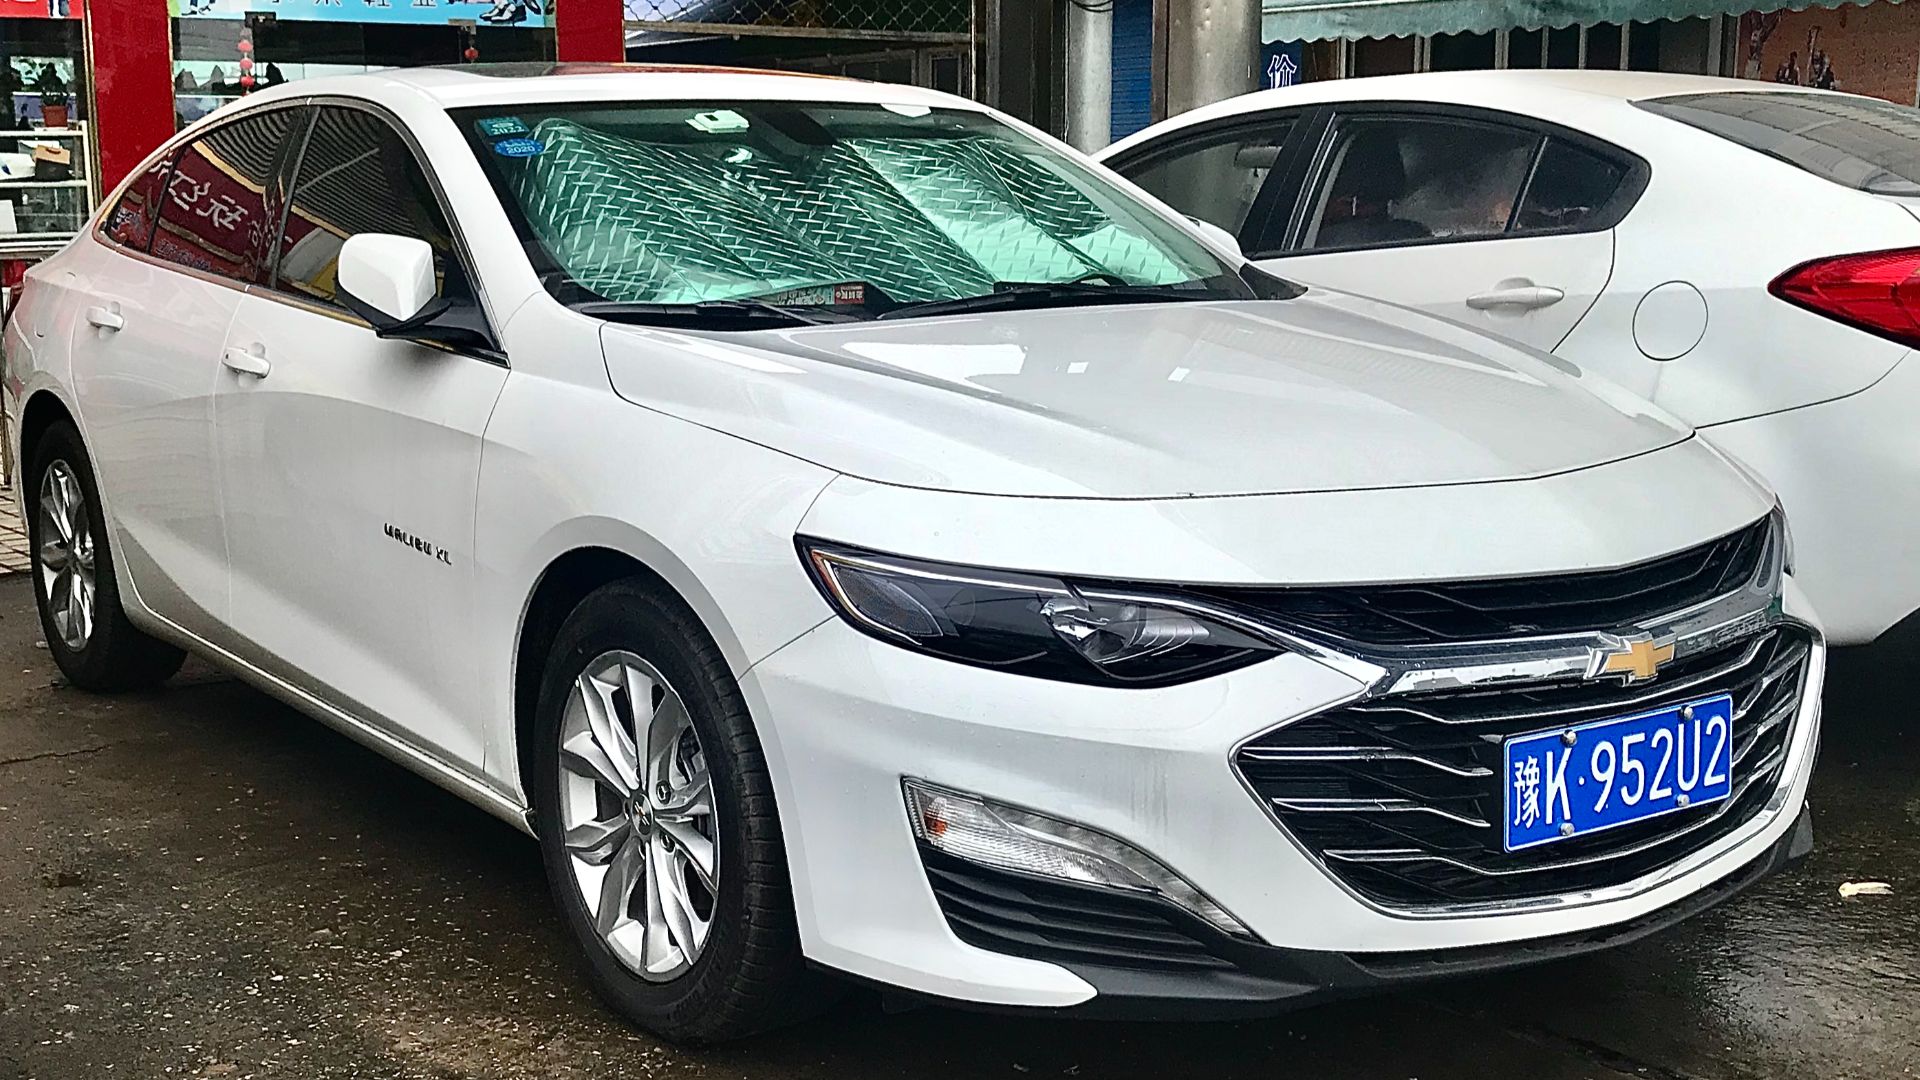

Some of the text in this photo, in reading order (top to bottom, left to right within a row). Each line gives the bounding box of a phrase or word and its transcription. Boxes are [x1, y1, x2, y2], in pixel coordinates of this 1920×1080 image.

[491, 125, 525, 135] 2022
[506, 146, 536, 154] 2020
[384, 522, 452, 566] MALIBU XL
